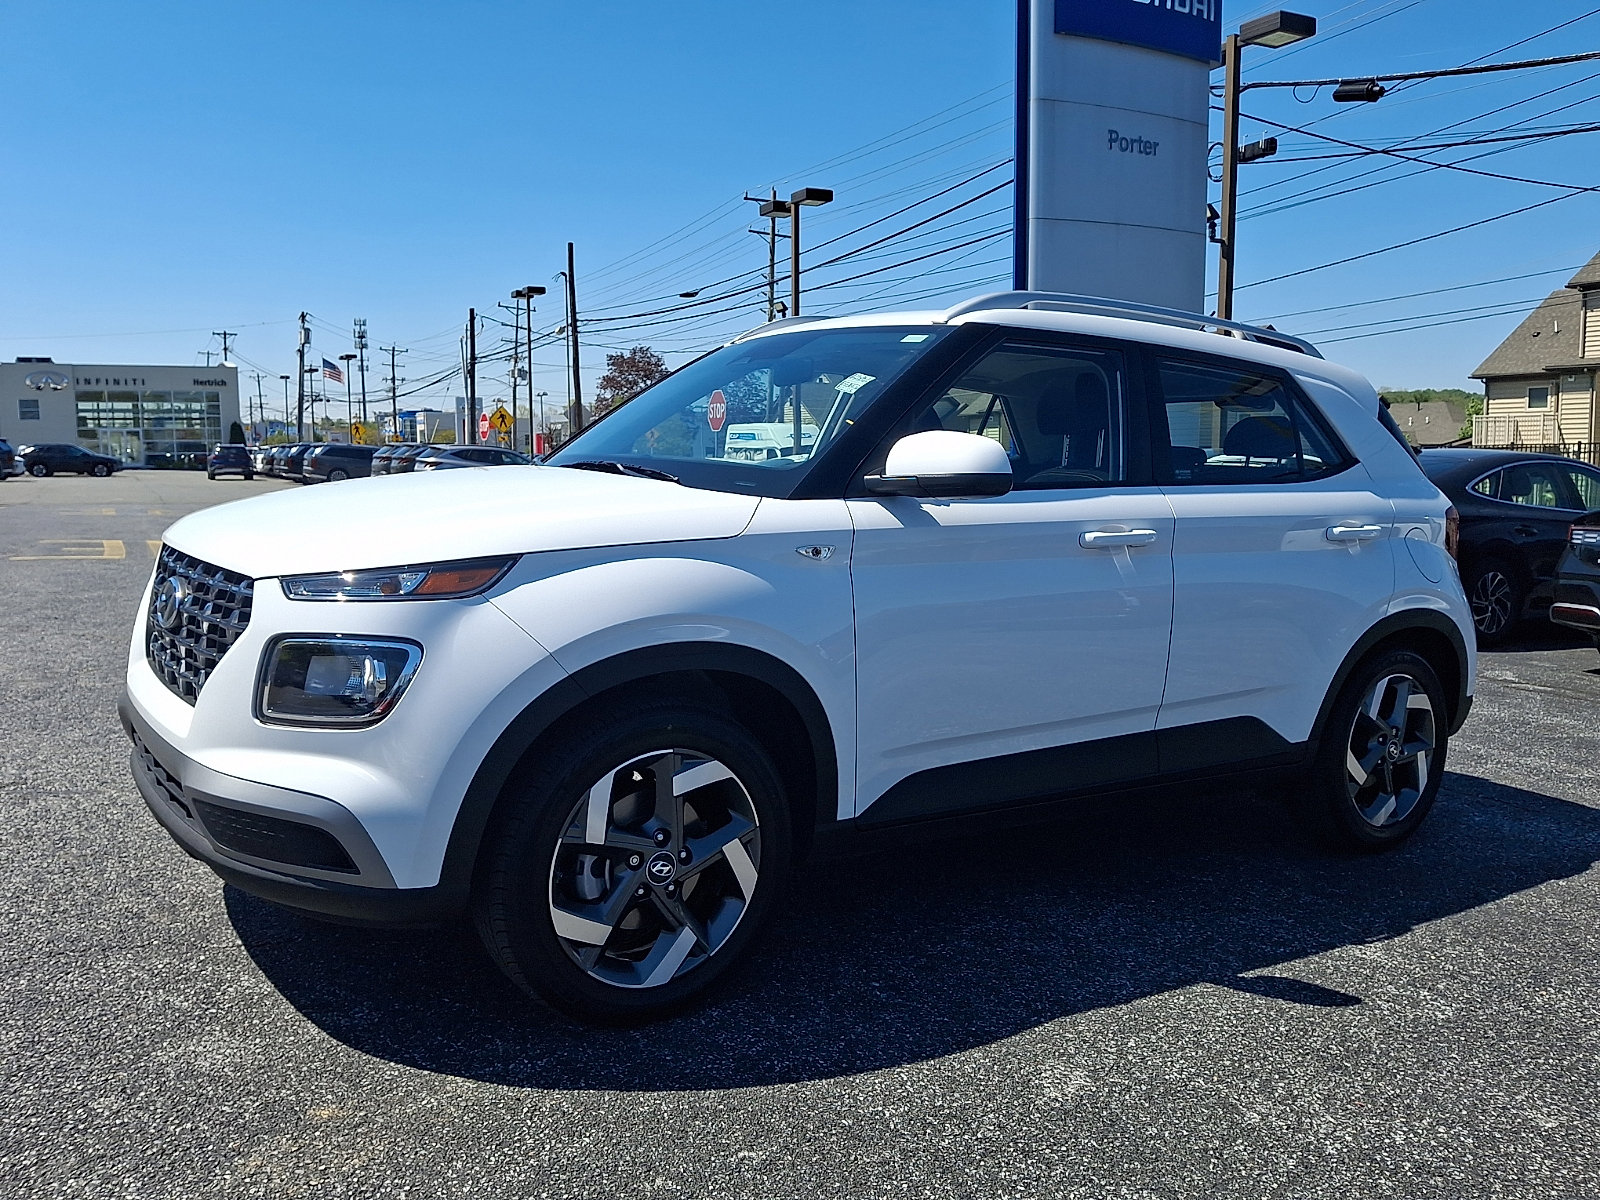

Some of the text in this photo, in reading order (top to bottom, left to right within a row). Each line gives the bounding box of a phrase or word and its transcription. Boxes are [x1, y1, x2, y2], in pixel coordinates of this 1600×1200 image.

[1107, 129, 1160, 157] Porter
[76, 378, 146, 386] INFINITI
[193, 378, 227, 387] Hertrich
[709, 403, 725, 418] STOP
